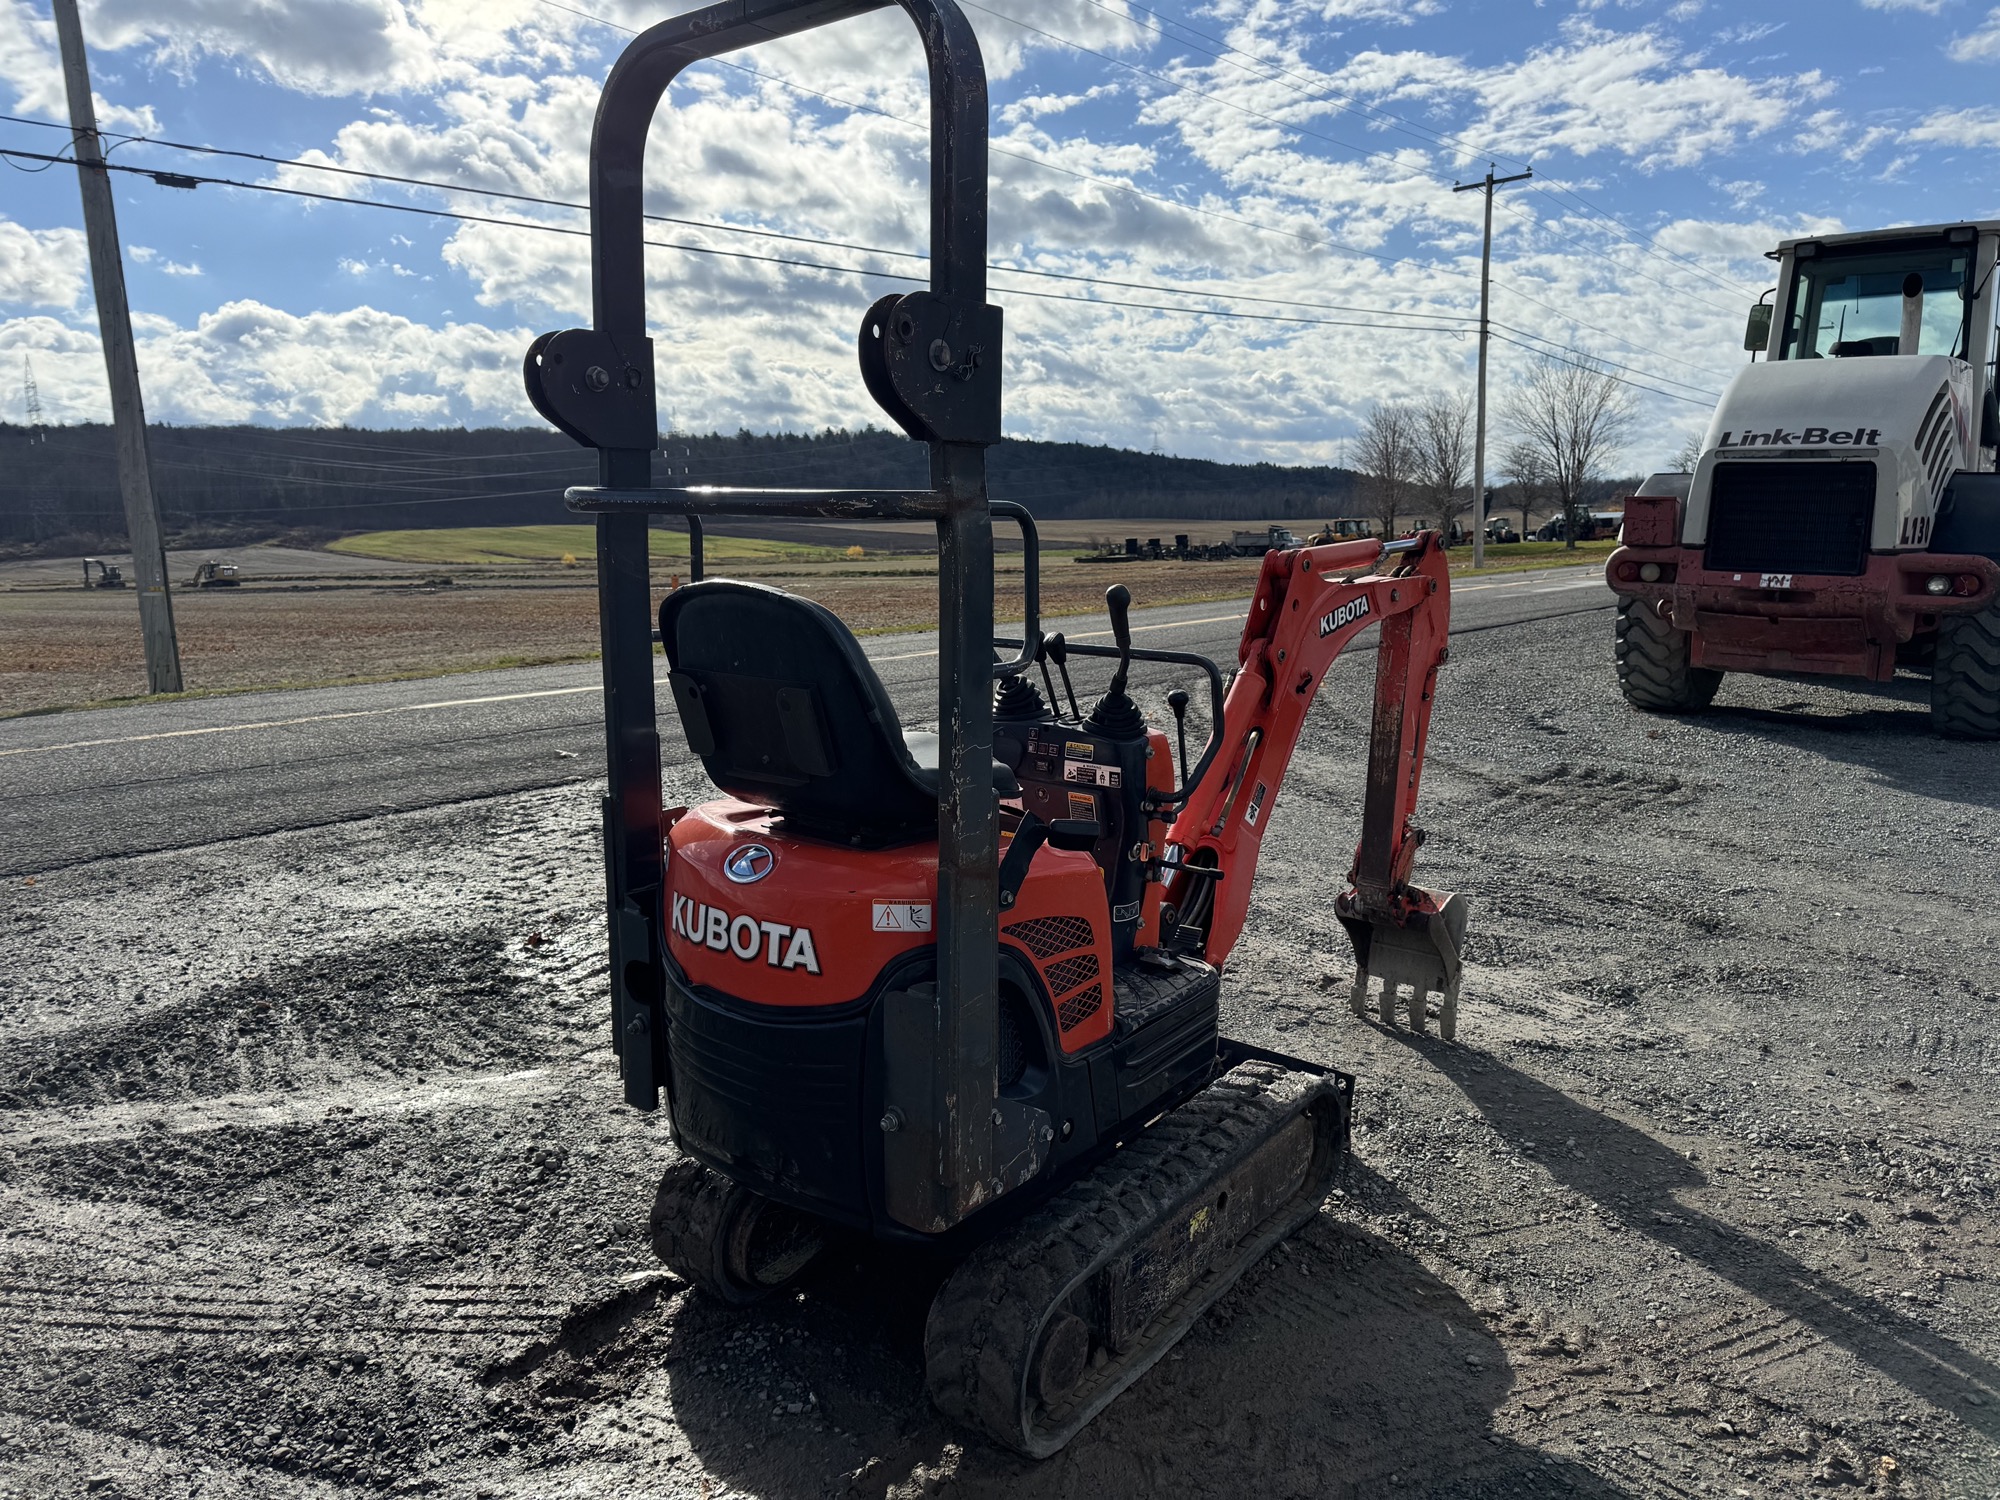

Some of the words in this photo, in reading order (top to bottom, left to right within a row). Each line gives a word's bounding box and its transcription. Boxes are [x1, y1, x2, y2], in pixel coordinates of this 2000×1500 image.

[1718, 428, 1881, 448] Link-Belt
[1320, 595, 1369, 636] KUBOTA
[672, 891, 821, 974] KUBOTA
